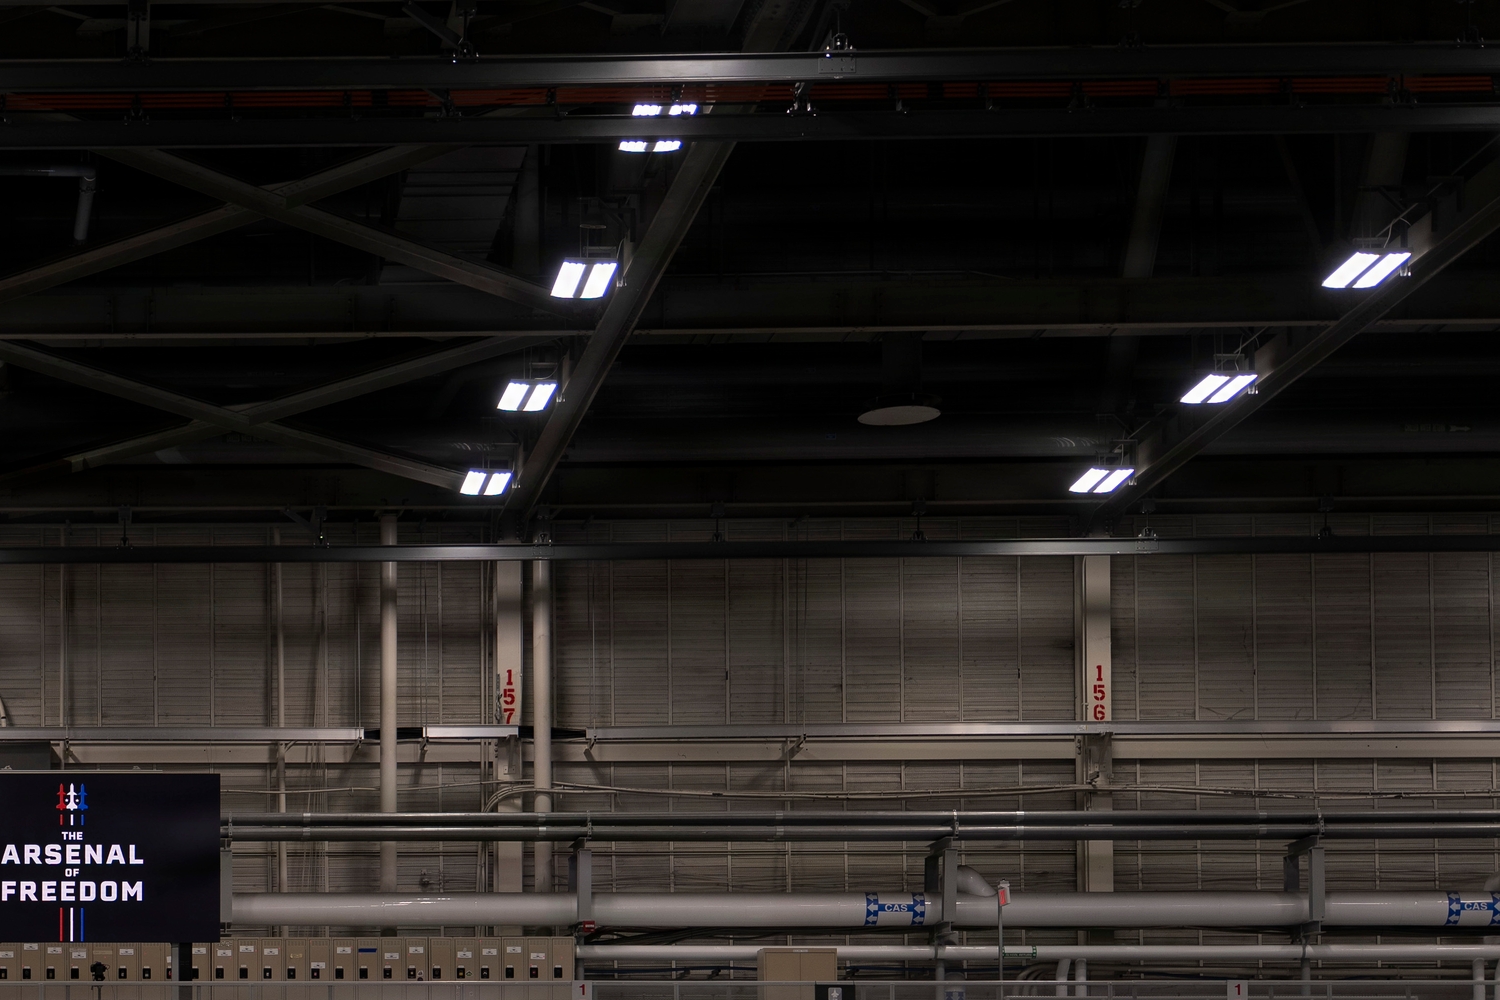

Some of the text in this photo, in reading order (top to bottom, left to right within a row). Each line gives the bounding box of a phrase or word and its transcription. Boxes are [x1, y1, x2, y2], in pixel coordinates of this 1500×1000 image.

[503, 669, 515, 724] 157
[1094, 664, 1106, 720] 156
[62, 832, 83, 840] THE
[0, 844, 144, 864] ARSENAL
[64, 868, 80, 877] OF
[1, 880, 143, 902] FREEDOM
[884, 904, 908, 912] CAS
[1464, 902, 1488, 910] CAS
